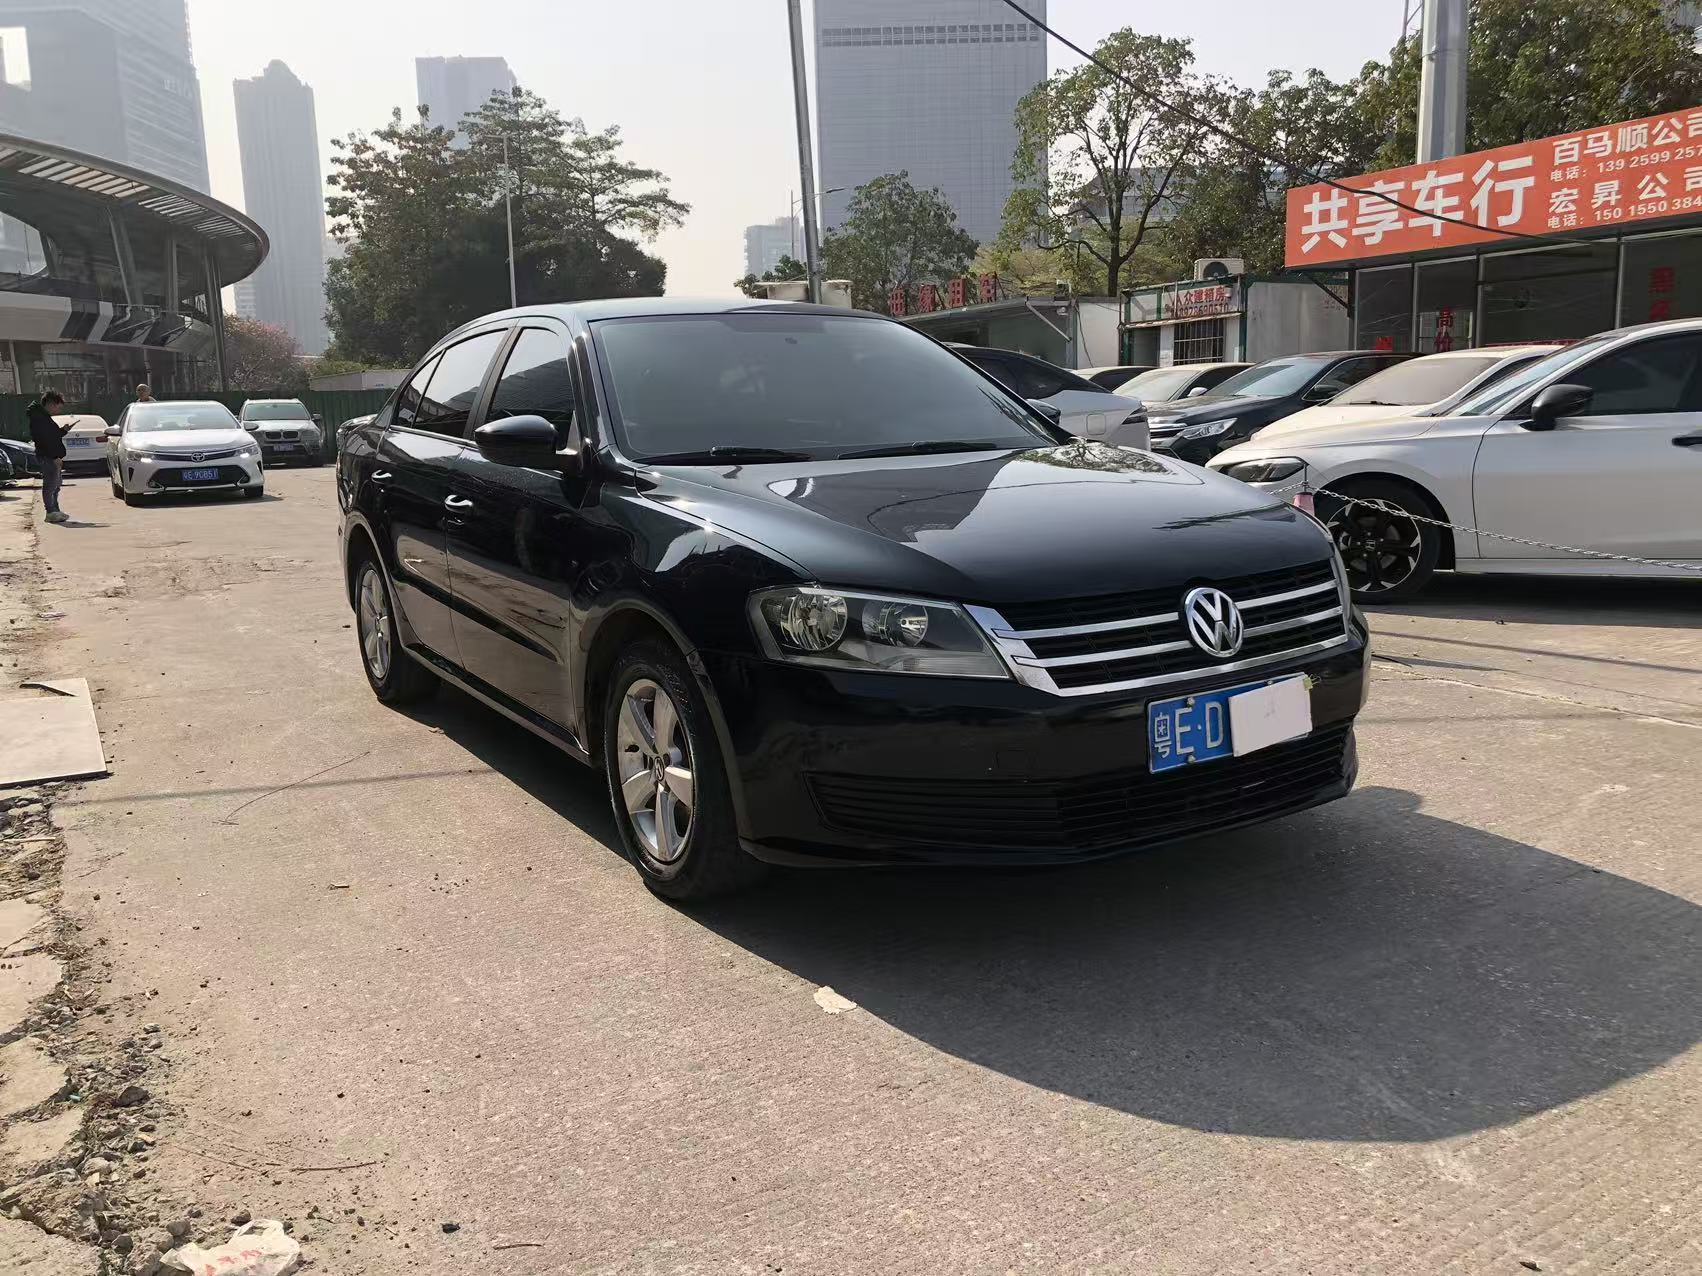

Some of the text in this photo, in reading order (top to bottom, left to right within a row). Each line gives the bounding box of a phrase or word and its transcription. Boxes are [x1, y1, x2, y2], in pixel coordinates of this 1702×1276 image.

[1552, 112, 1702, 166] 百马顺公司
[1597, 159, 1625, 174] 139
[1629, 150, 1670, 168] 2599
[1300, 155, 1535, 254] 共享车行
[1594, 208, 1622, 222] 150
[1628, 200, 1667, 217] 1550
